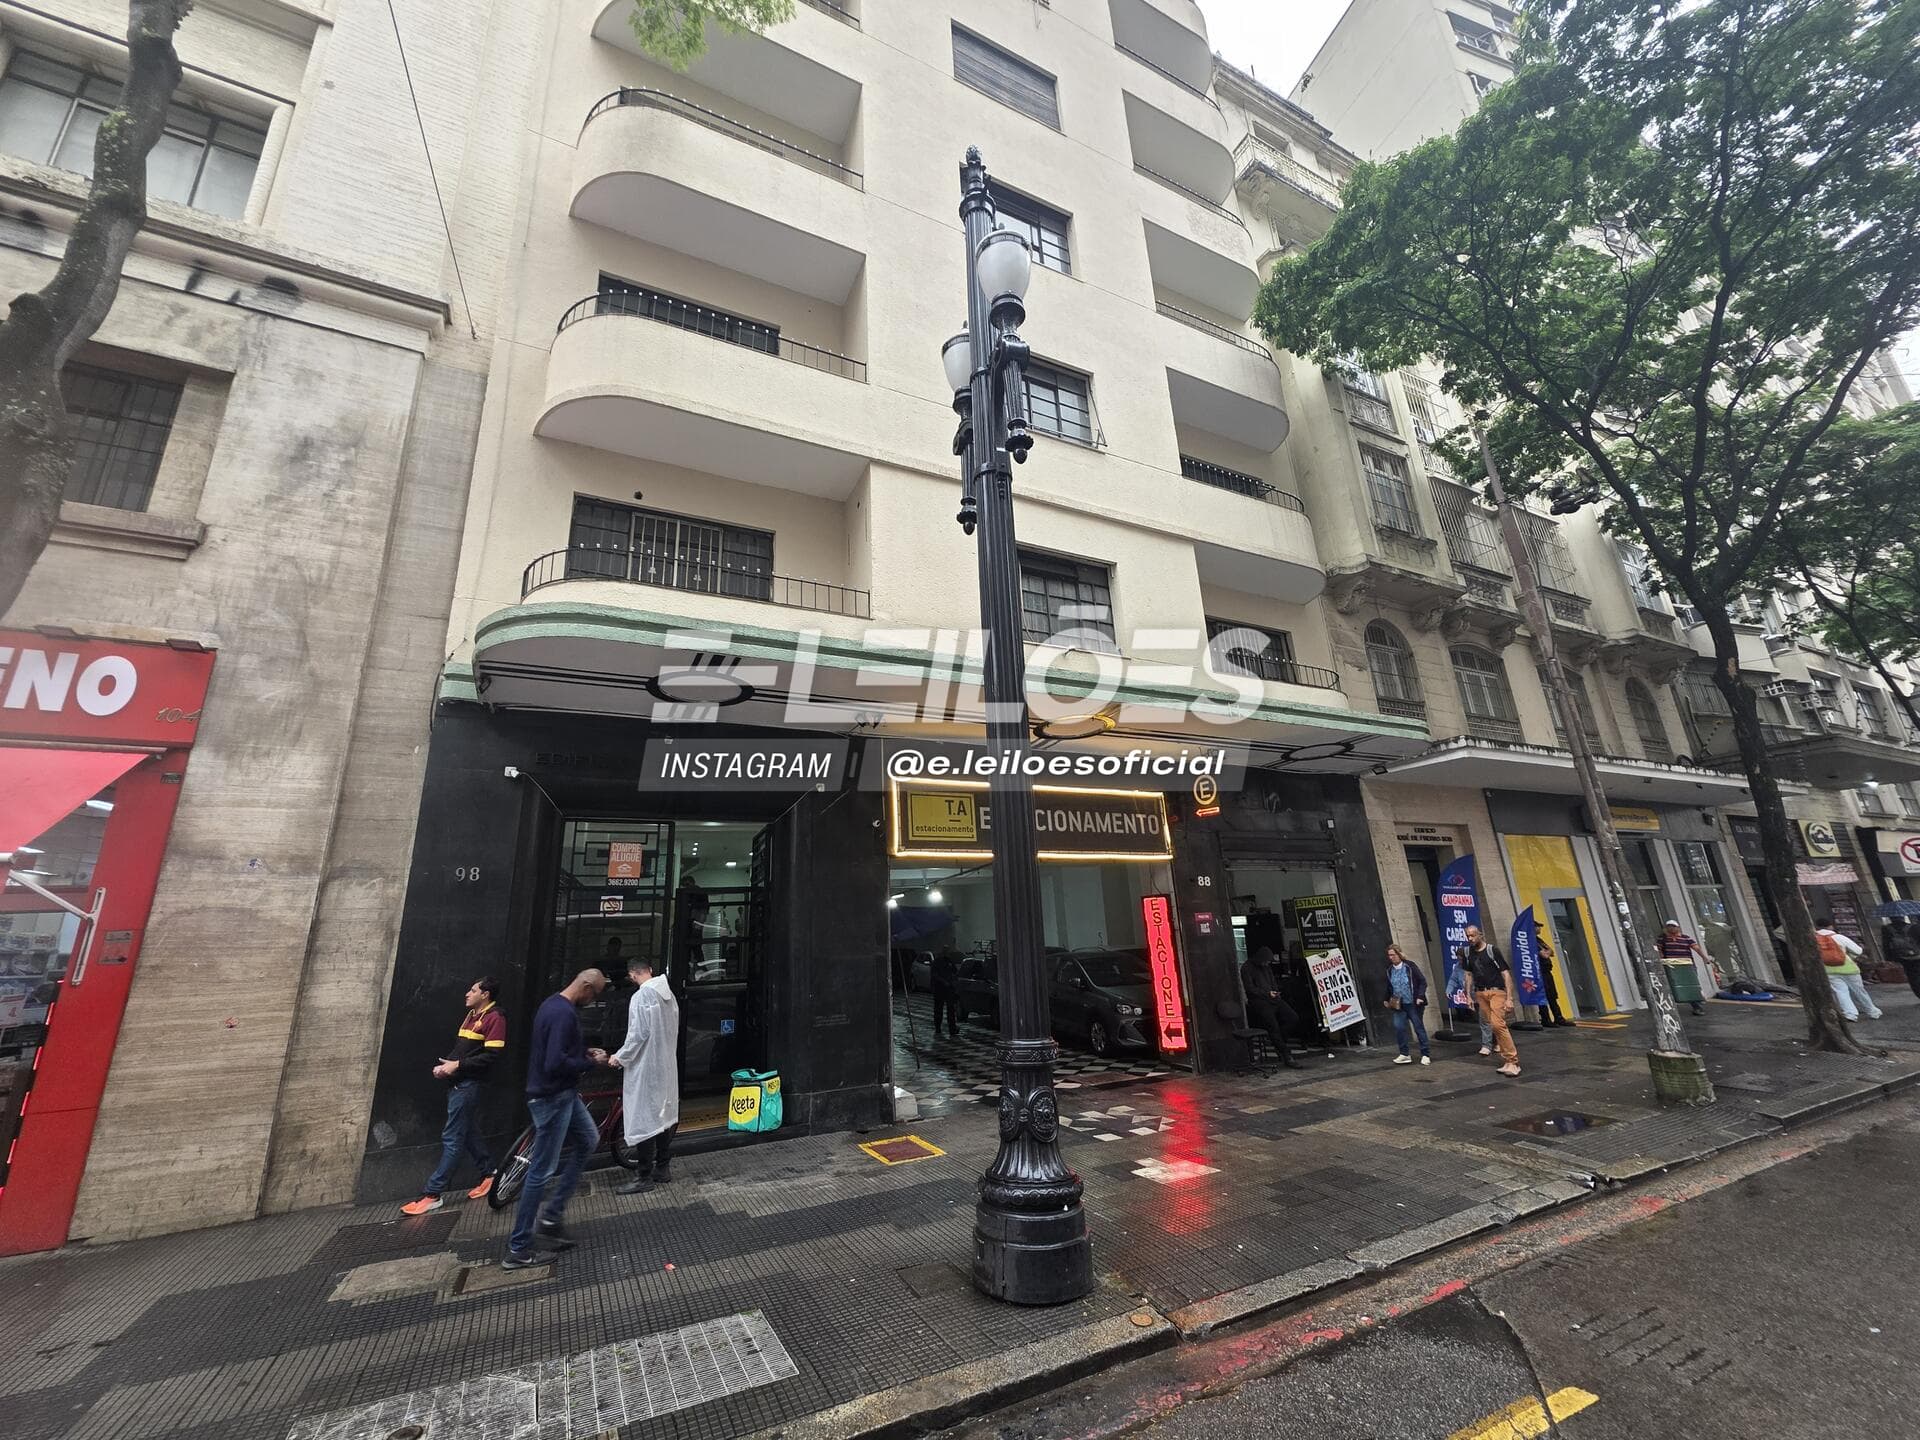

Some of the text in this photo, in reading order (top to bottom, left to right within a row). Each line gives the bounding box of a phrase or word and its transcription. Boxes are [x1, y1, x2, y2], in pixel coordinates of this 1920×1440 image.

[0, 646, 138, 716] NO
[156, 708, 201, 723] 104
[944, 799, 968, 816] T.A
[915, 824, 975, 833] estacionamento
[979, 806, 1160, 836] ECIONAMENTO
[612, 843, 641, 853] COMPRE
[610, 852, 641, 863] ALUGUE
[455, 866, 480, 882] 98
[1197, 876, 1211, 887] 88
[1295, 896, 1336, 908] ESTACIONE
[1443, 894, 1474, 907] CAMPANHA
[1453, 909, 1468, 924] SEM
[1150, 898, 1176, 1017] ESTACIONE
[1516, 930, 1534, 979] Hapvida
[1311, 955, 1344, 976] ESTACIONE
[1317, 973, 1339, 994] SEM
[1323, 985, 1355, 1009] PARAR
[731, 1095, 755, 1114] keeta
